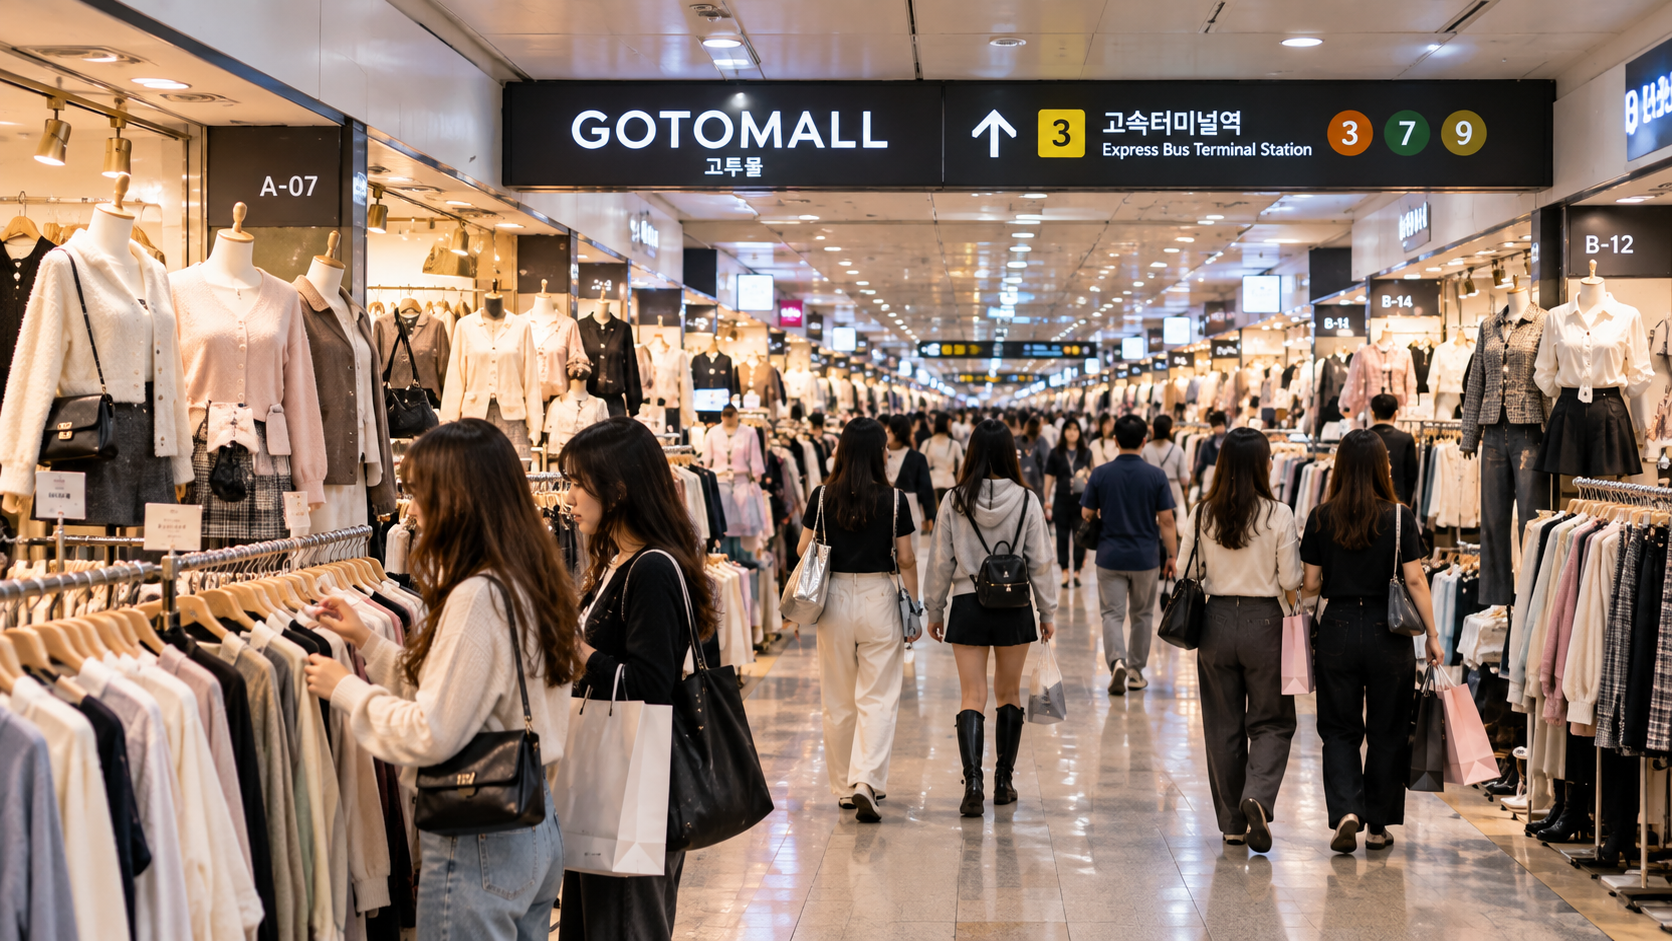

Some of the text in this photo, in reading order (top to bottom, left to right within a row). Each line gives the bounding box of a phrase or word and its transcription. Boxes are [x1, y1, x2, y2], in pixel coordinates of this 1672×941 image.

[571, 109, 888, 149] GOTOMALL
[1052, 119, 1071, 147] 3
[1102, 110, 1241, 136] 고속터미널역
[1341, 121, 1473, 146] 3 7 9
[1102, 141, 1312, 160] Express Bus Terminal Station
[259, 175, 318, 197] A-07
[1585, 234, 1634, 254] B-12
[1381, 294, 1414, 309] B-14
